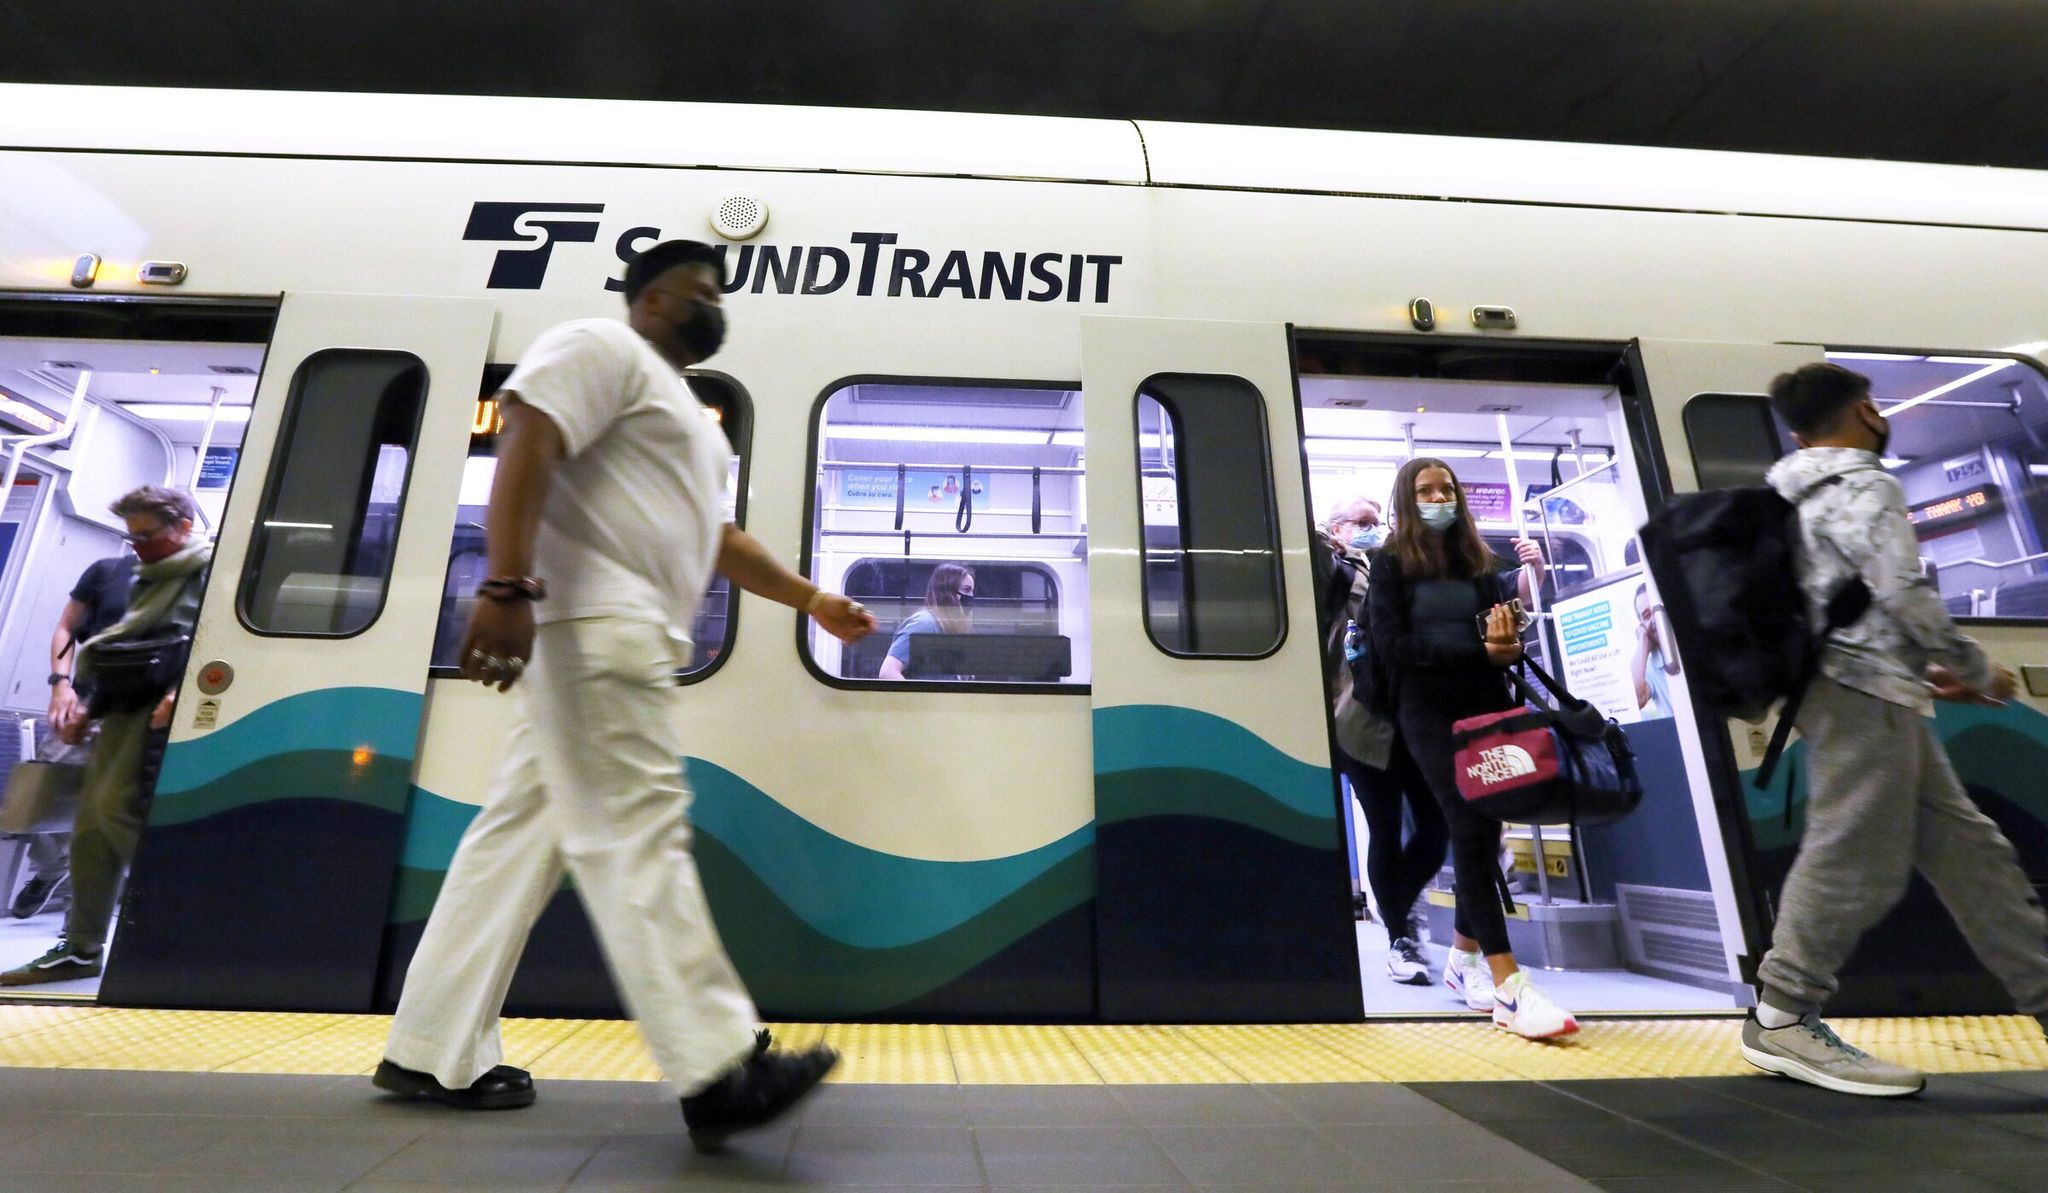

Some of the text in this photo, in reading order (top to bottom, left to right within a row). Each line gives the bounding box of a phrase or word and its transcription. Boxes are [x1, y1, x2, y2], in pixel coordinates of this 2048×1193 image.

[848, 474, 873, 482] Cover
[874, 475, 893, 484] your
[1948, 461, 1985, 481] 125A
[848, 482, 871, 490] when
[871, 483, 887, 491] you
[1924, 498, 1964, 519] THANK
[1478, 748, 1506, 762] THE
[1466, 760, 1510, 779] NORTH
[1481, 769, 1514, 786] FACE
